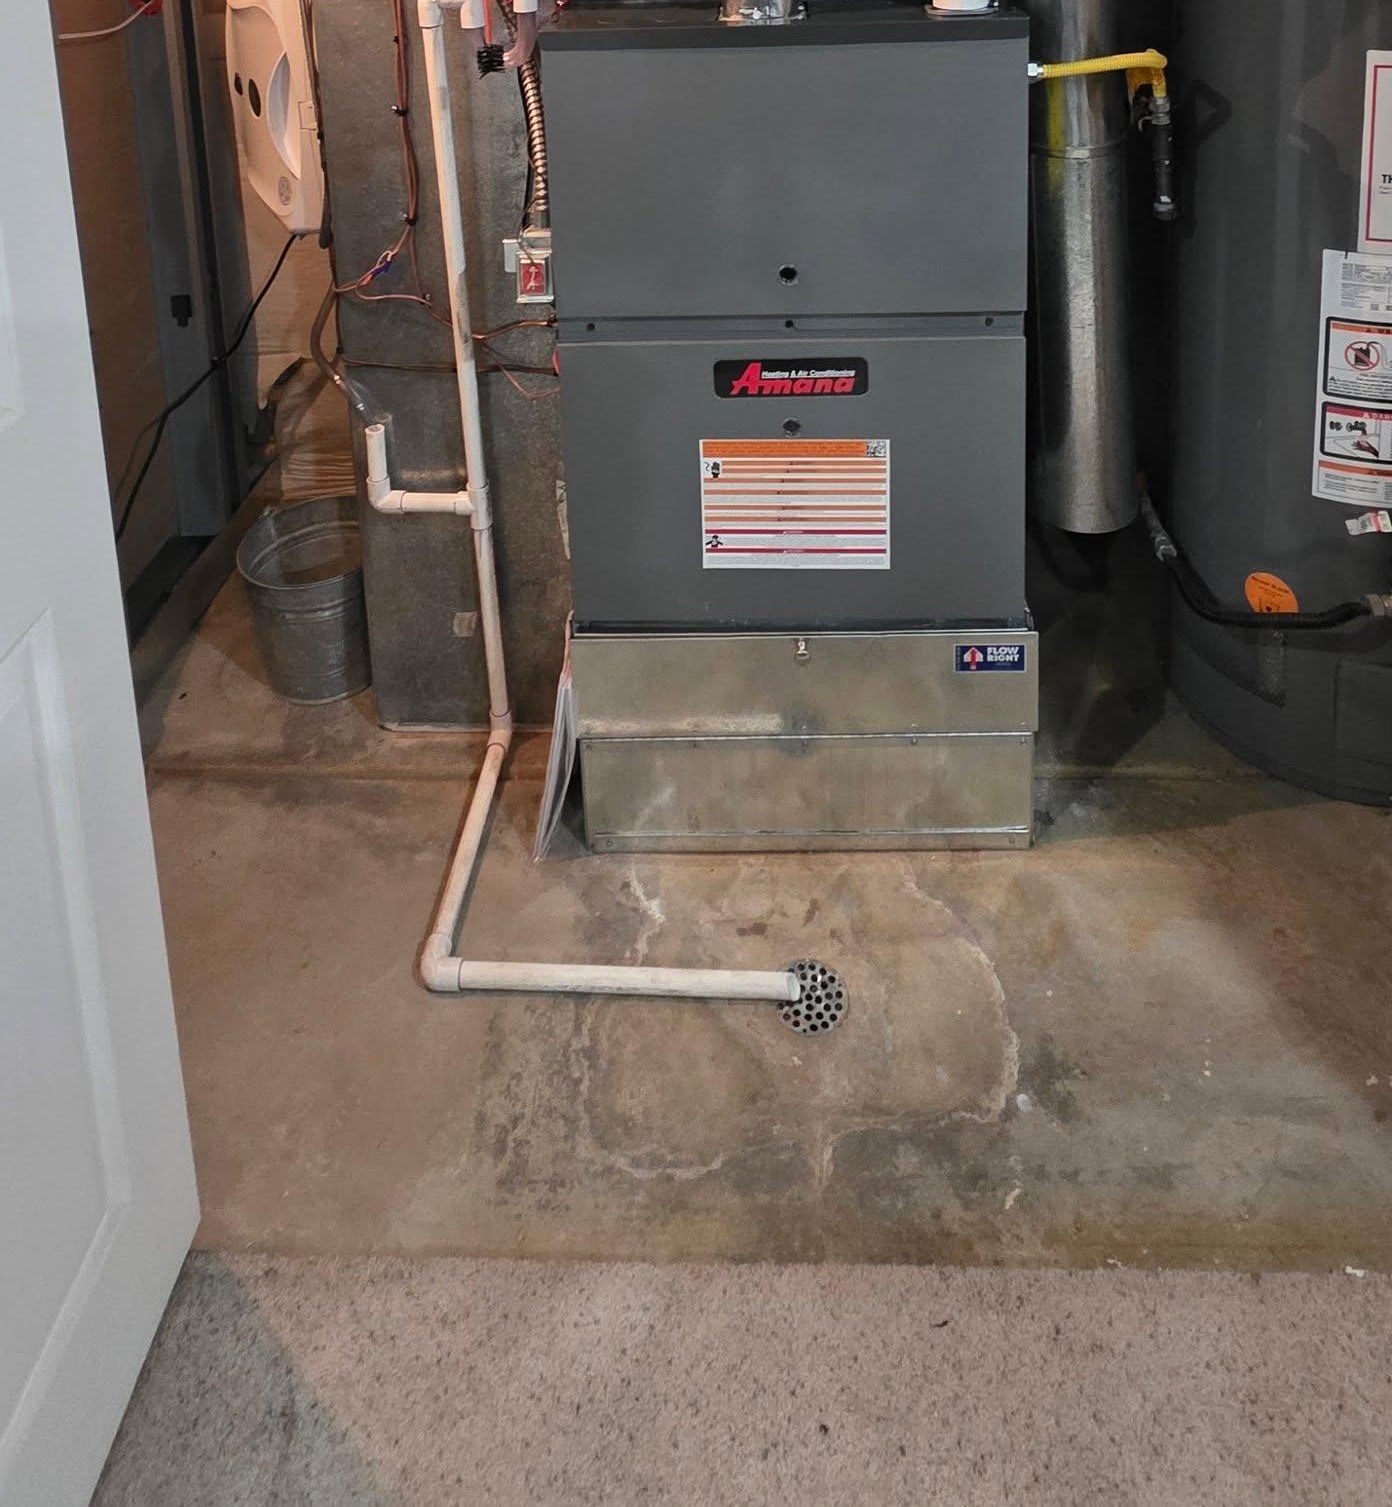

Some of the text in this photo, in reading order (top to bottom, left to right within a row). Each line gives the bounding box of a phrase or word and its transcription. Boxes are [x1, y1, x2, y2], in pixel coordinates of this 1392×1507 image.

[797, 370, 809, 378] Air
[730, 362, 856, 395] Amana
[986, 646, 1020, 655] FLOW
[986, 654, 1020, 662] RIGHT
